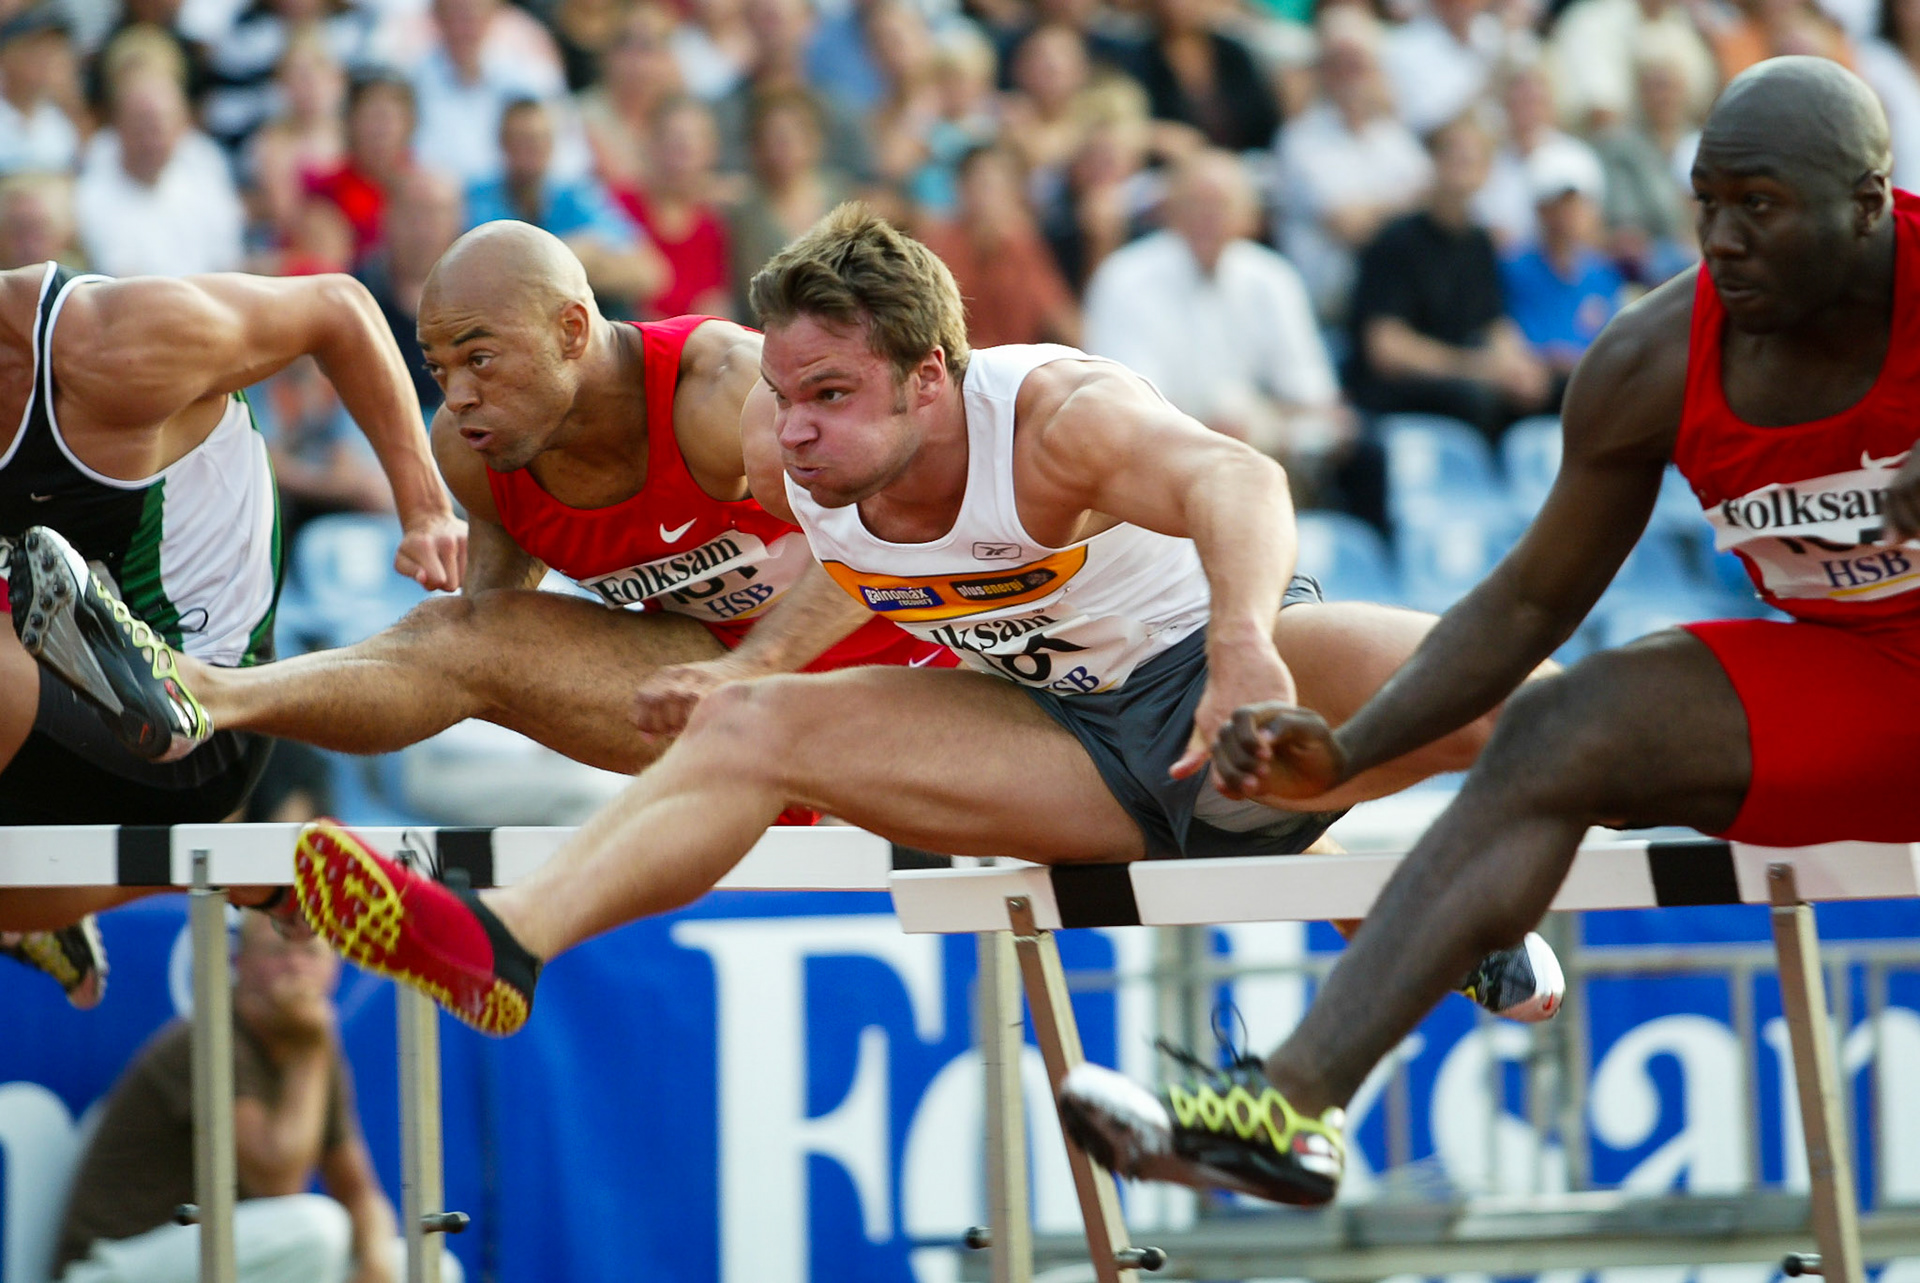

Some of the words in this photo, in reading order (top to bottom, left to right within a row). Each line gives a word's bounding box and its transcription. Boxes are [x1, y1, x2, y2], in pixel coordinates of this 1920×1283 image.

[592, 536, 743, 606] Folksam
[1820, 549, 1911, 588] HSB
[703, 582, 775, 618] HSB
[864, 586, 929, 604] gainomax
[929, 614, 1060, 654] lksam
[1045, 665, 1100, 693] SB
